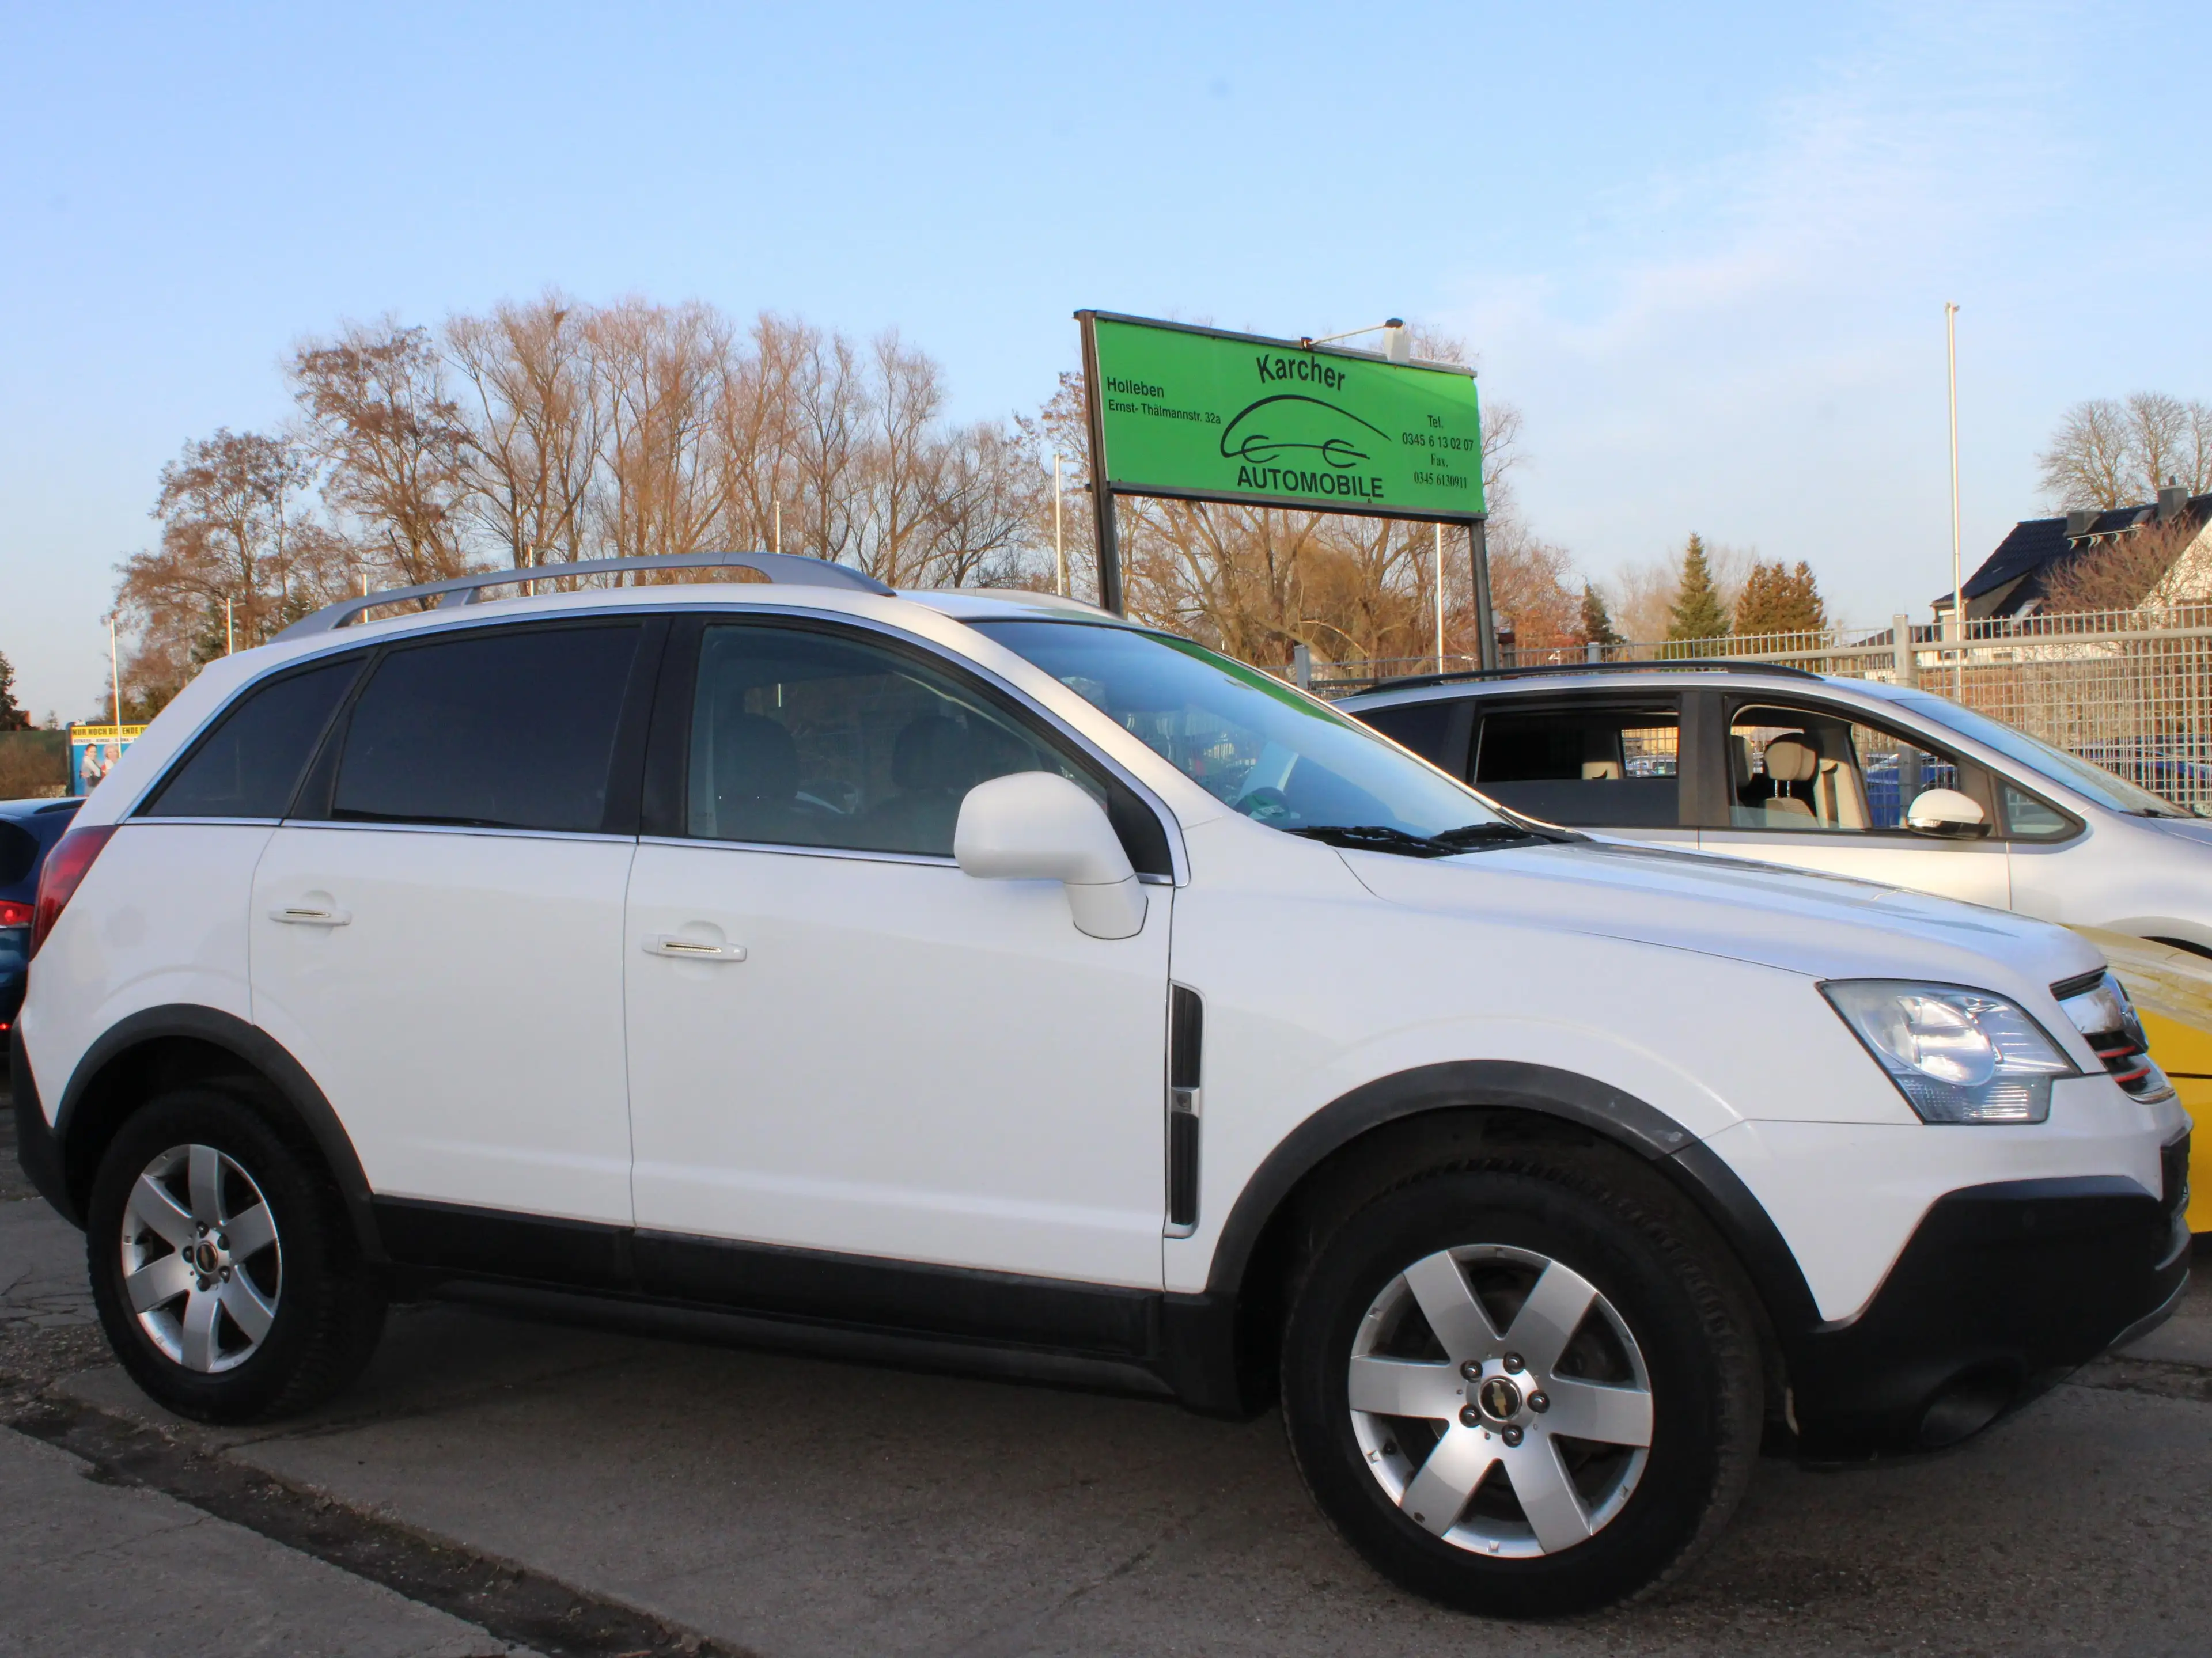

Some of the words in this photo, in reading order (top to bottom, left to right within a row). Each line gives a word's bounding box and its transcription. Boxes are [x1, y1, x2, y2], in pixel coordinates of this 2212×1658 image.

[1256, 354, 1346, 391] Karcher
[1107, 377, 1164, 398] Holleben
[1108, 399, 1138, 413] Ernst-
[1141, 403, 1202, 422] Thälmannstr.
[1205, 412, 1221, 424] 32a
[1427, 415, 1444, 428] Tel.
[1402, 432, 1426, 446] 0345
[1429, 435, 1434, 447] 6
[1438, 436, 1448, 449] 13
[1450, 437, 1461, 450] 02
[1463, 439, 1474, 451] 07
[1430, 453, 1448, 468] Fax.
[1237, 465, 1384, 498] AUTOMOBILE
[1414, 471, 1434, 485] 0345
[73, 728, 86, 736] NUR
[88, 727, 107, 735] NOCH
